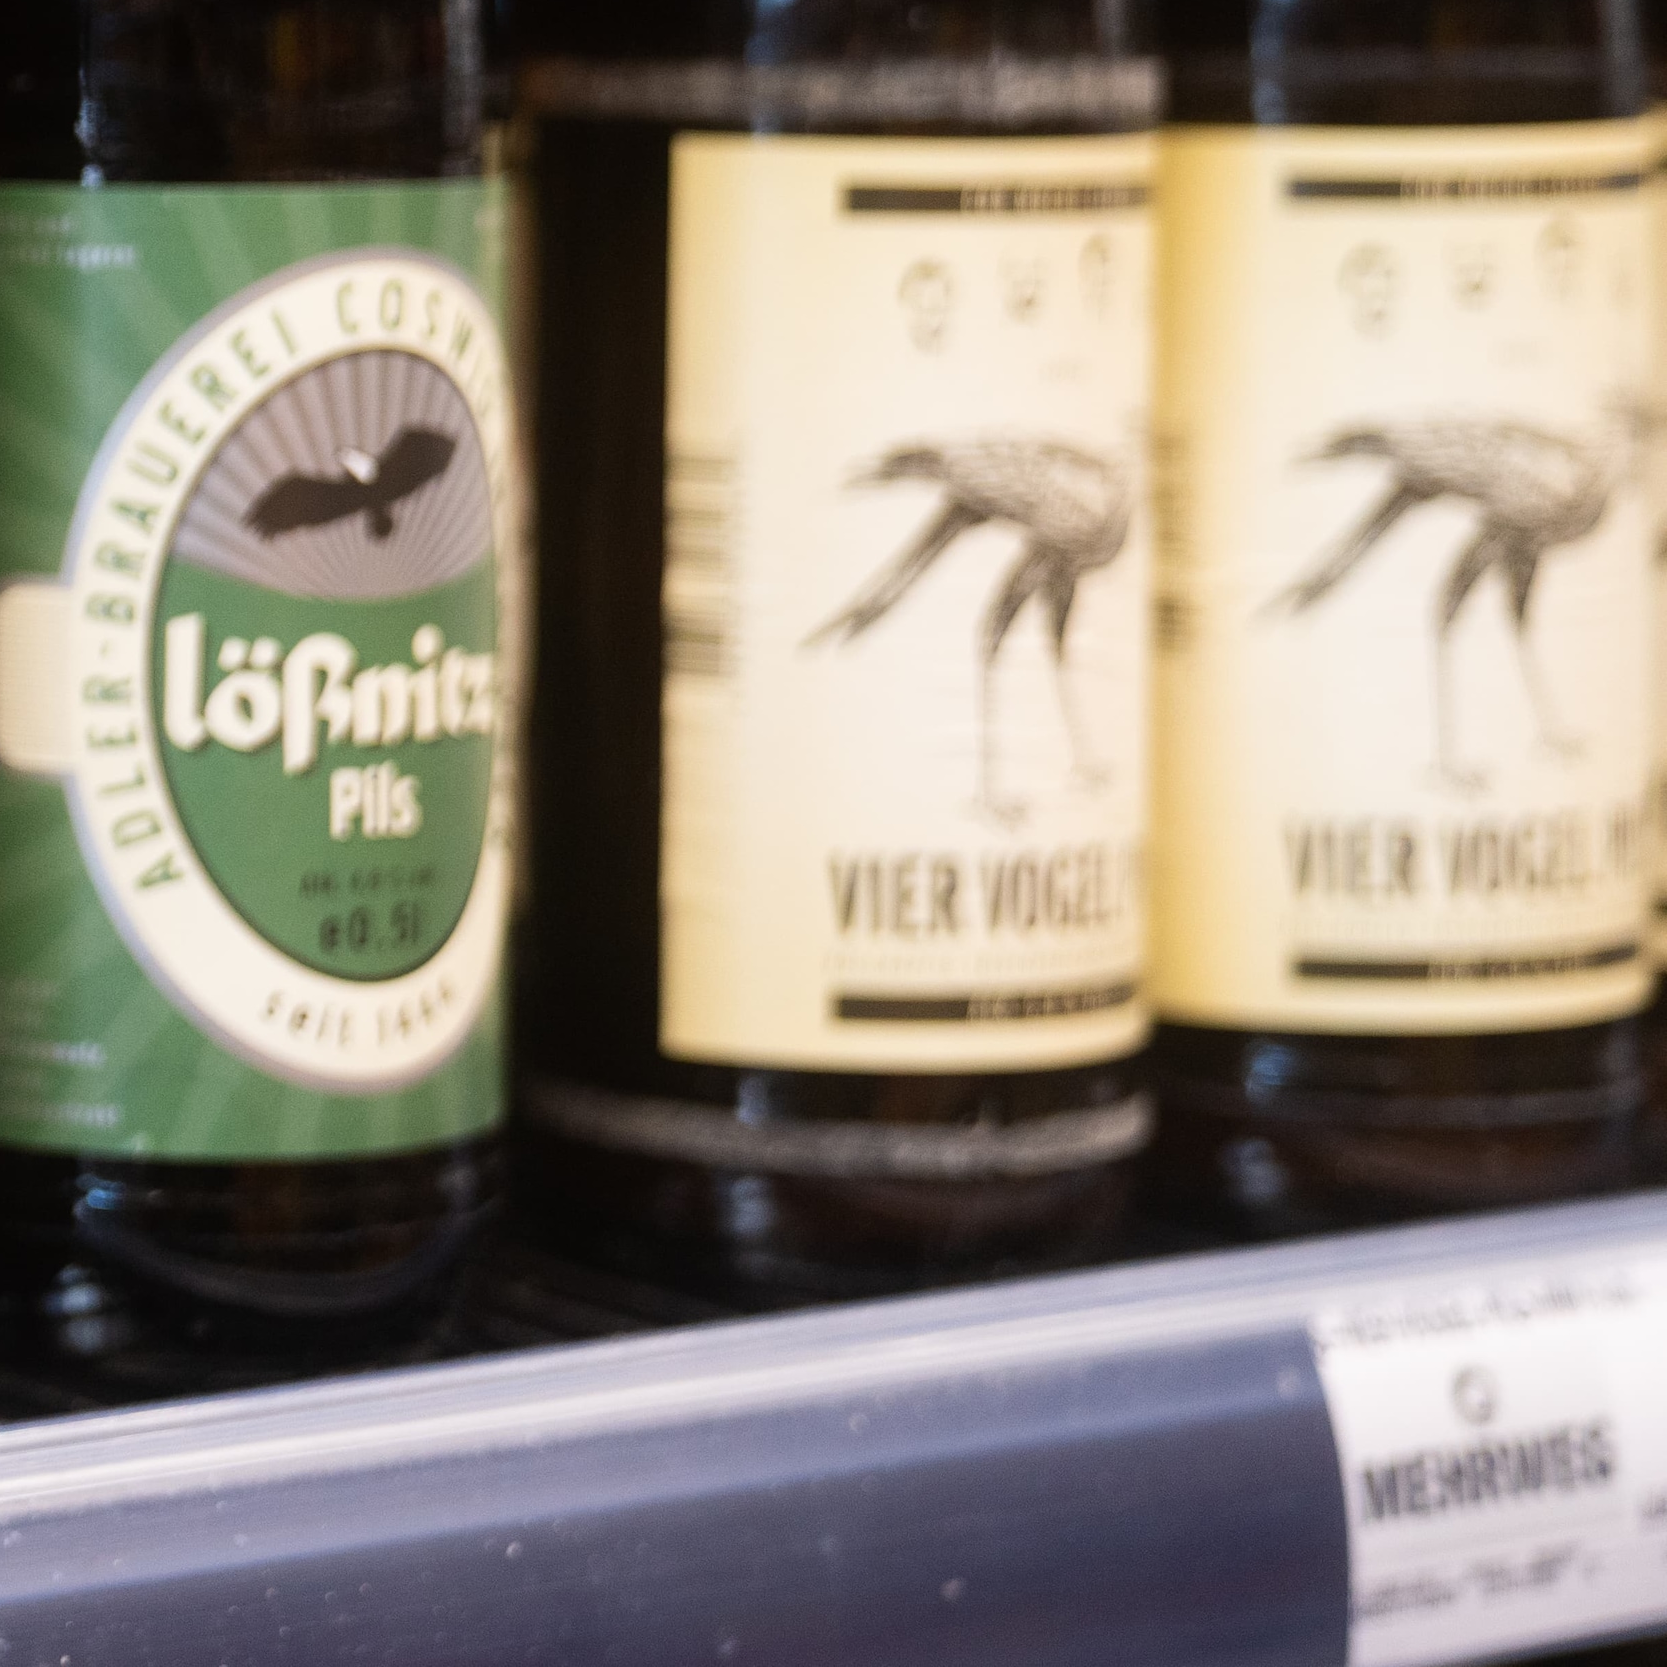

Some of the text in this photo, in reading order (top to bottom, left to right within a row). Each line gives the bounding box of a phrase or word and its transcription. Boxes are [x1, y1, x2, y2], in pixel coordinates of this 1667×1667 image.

[164, 612, 497, 774] lößnitz
[328, 762, 420, 839] Pils
[827, 846, 959, 938] VIER
